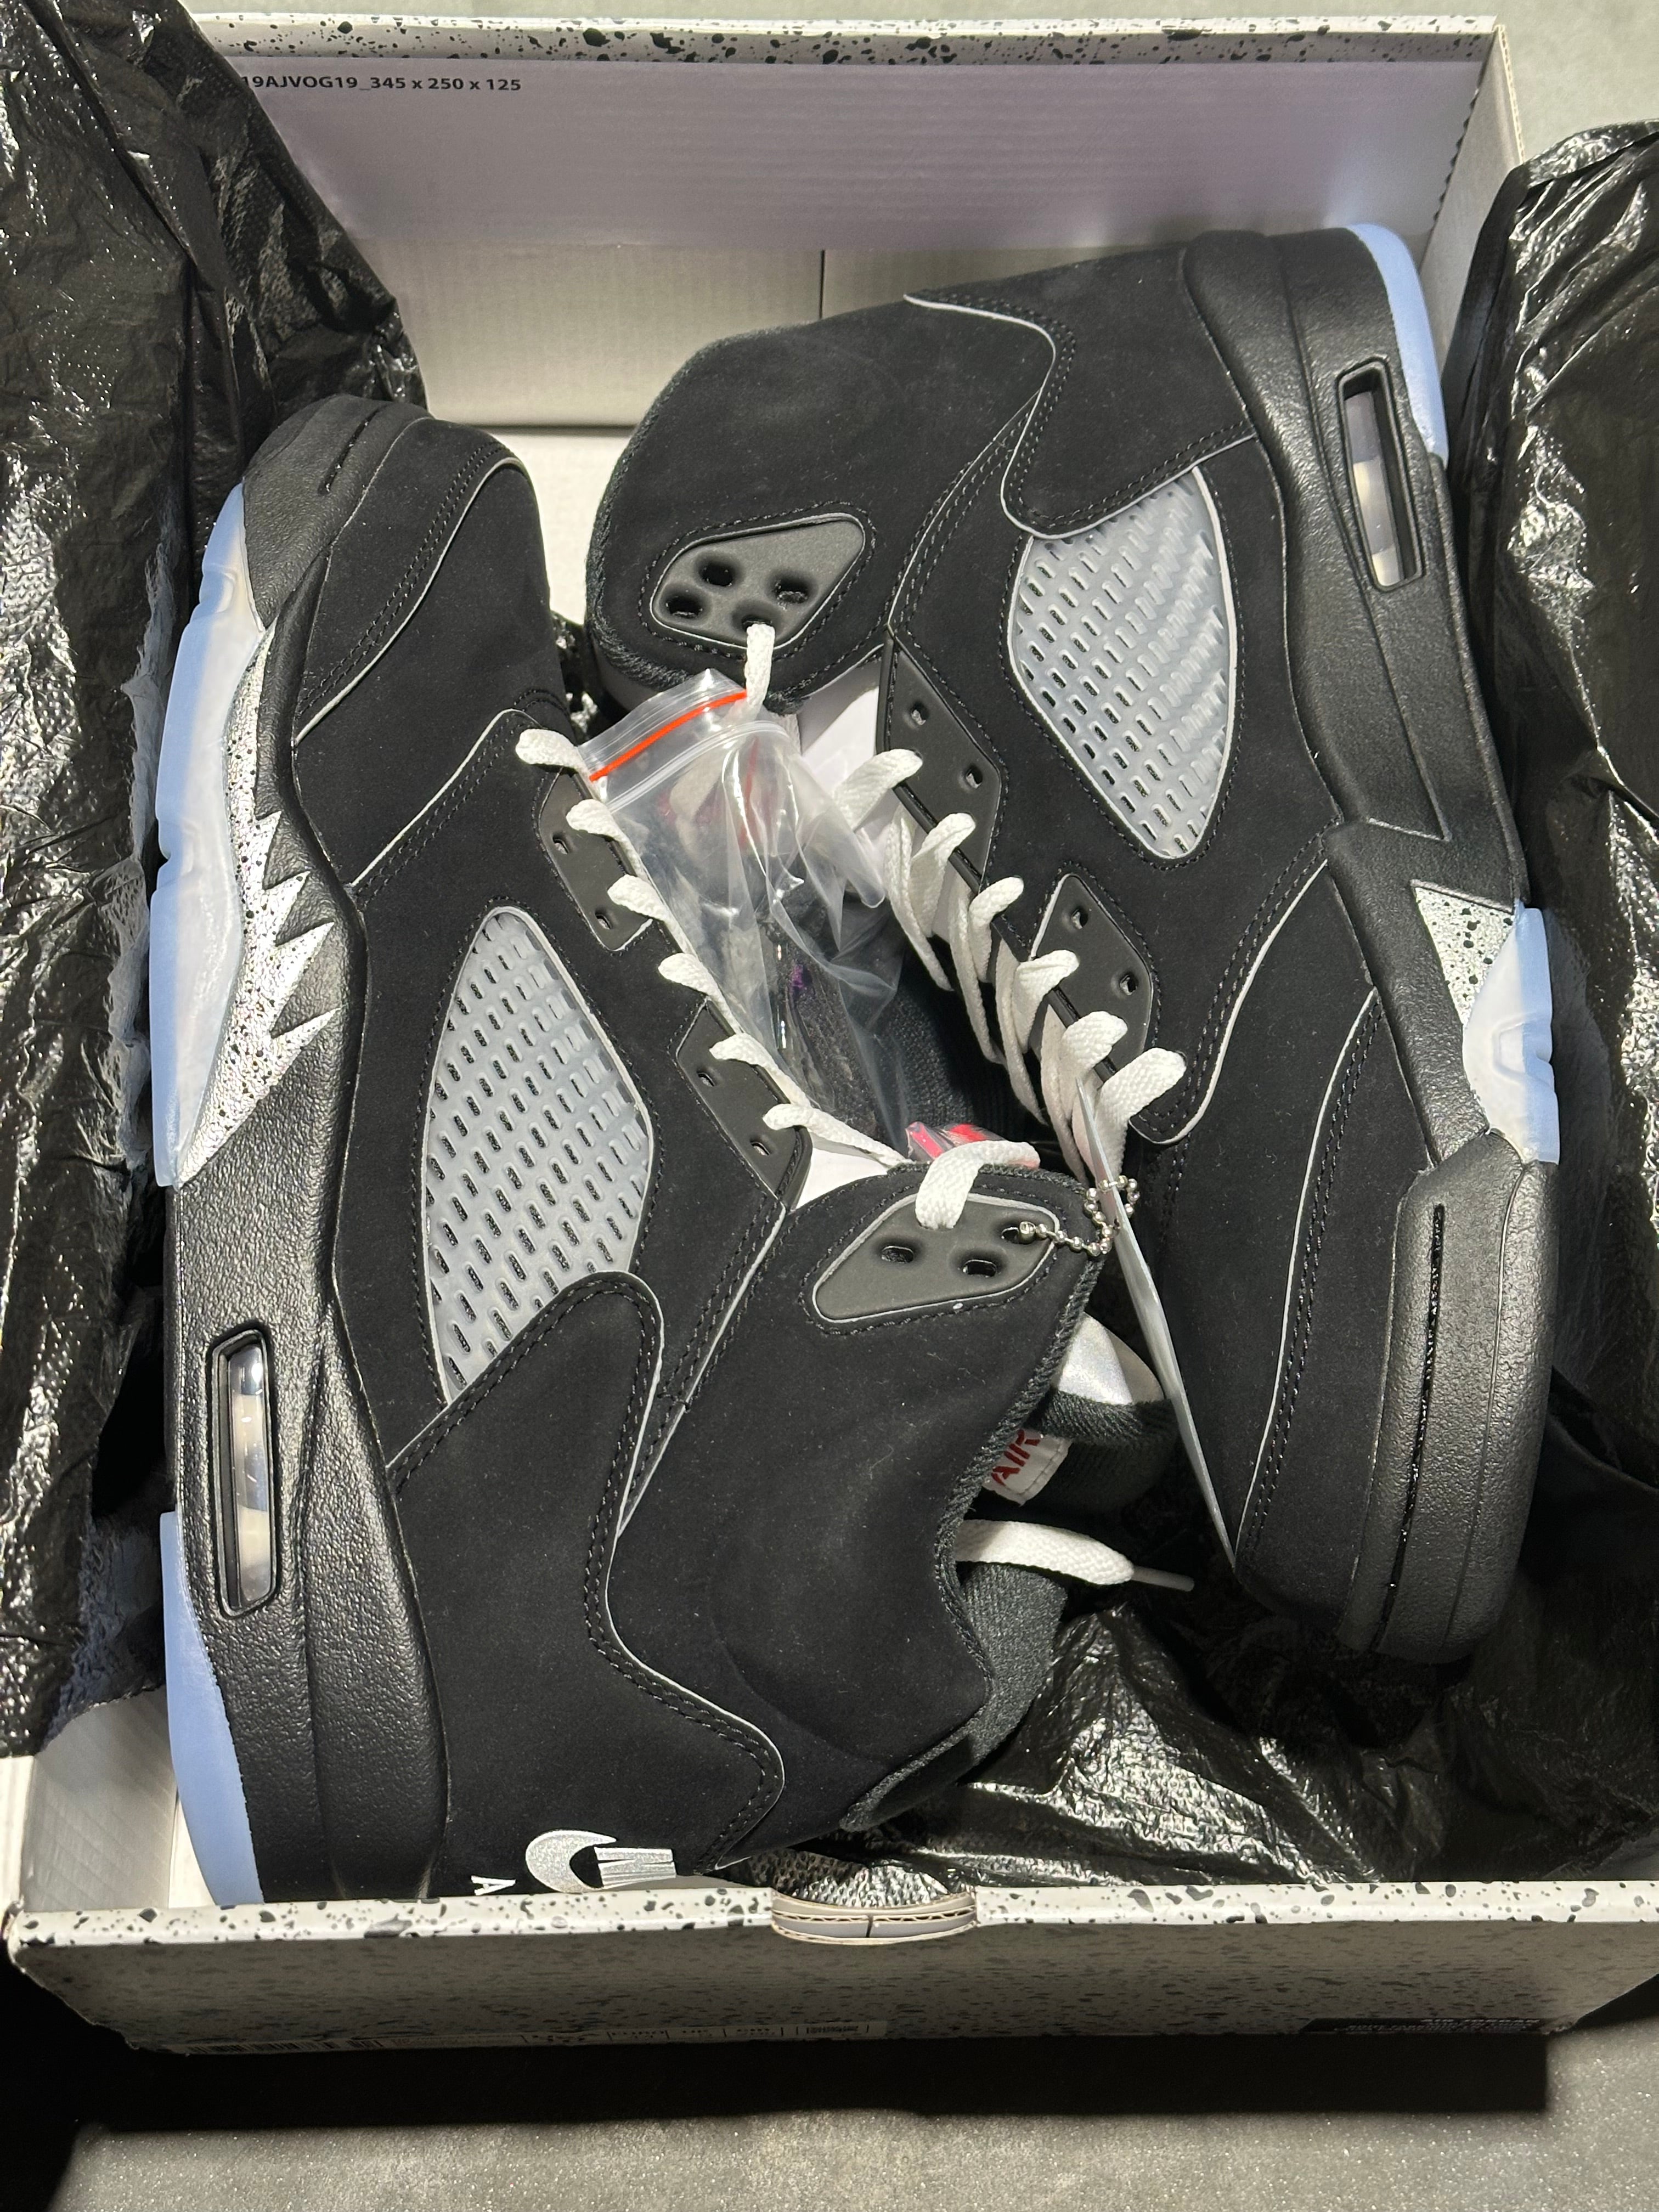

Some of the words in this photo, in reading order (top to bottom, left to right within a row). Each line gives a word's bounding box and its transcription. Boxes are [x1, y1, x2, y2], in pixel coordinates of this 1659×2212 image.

[411, 80, 423, 89] x
[427, 77, 464, 90] 250
[469, 81, 481, 90] x
[486, 79, 521, 91] 125
[991, 1429, 1041, 1486] AIR
